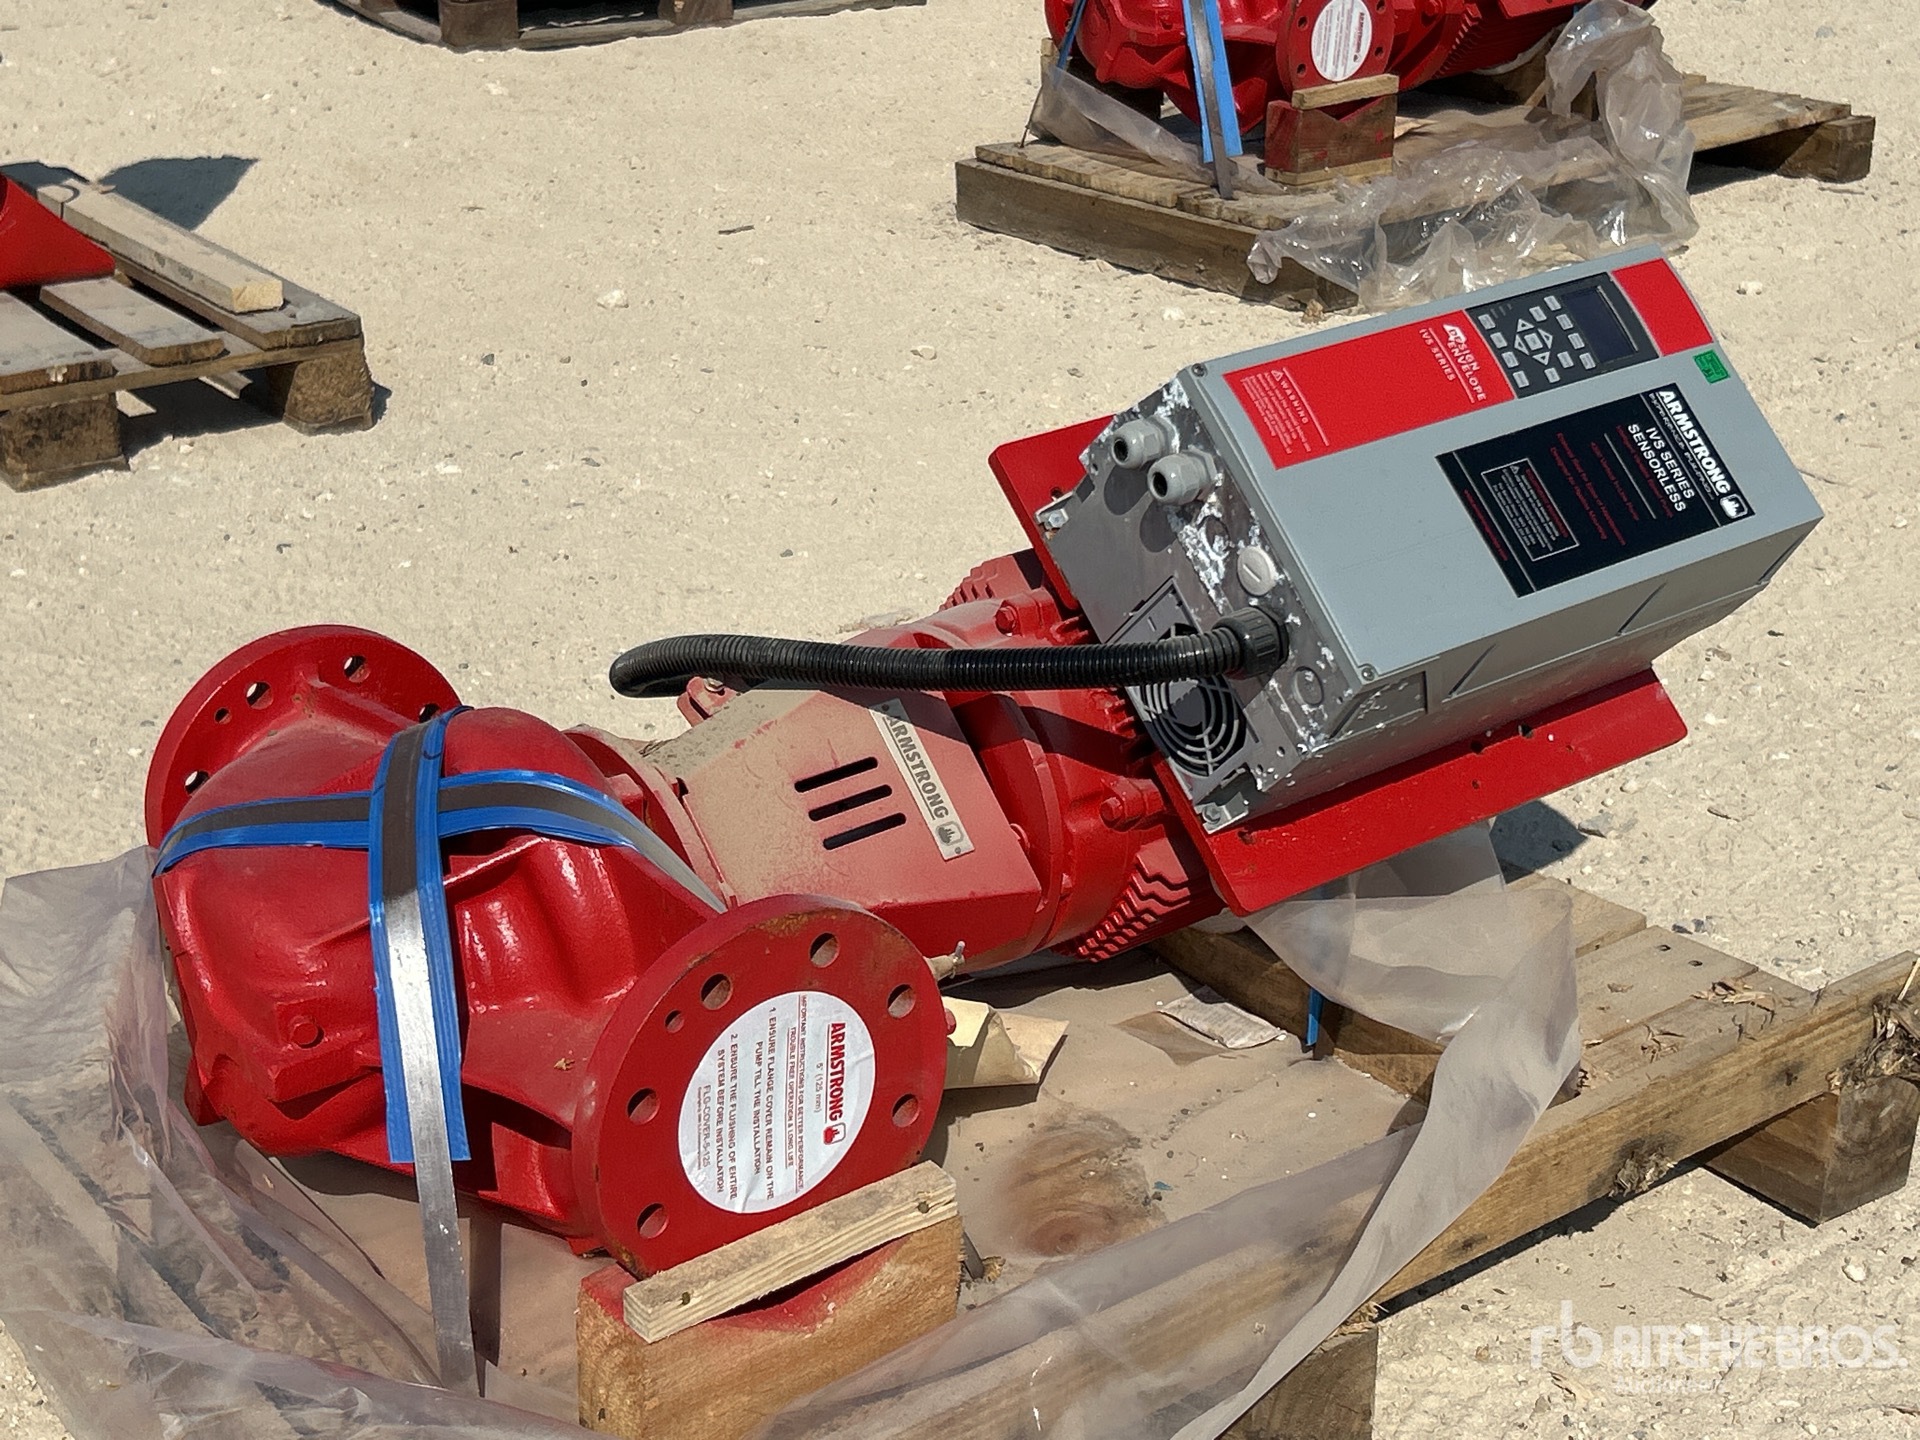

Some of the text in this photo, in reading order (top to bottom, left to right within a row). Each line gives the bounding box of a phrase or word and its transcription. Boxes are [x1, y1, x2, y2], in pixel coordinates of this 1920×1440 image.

[1417, 327, 1456, 381] IVS SERIES
[1446, 340, 1487, 401] ENVELOPE
[1279, 380, 1308, 423] WARNING
[1658, 388, 1733, 494] ARMSTRONG
[1626, 423, 1687, 511] SENSORLESS
[1644, 426, 1695, 499] IVS SERIES
[885, 714, 950, 819] ARMSTRONG
[756, 1041, 764, 1067] PUMP
[769, 1017, 777, 1054] ENSURE
[767, 1057, 775, 1092] FLANGE
[815, 1074, 823, 1092] (125
[830, 1023, 846, 1121] ARMSTRONG
[717, 1089, 725, 1126] BEFORE
[730, 1083, 738, 1102] THE
[754, 1089, 762, 1108] THE
[729, 1104, 737, 1149] FLUSHING
[729, 1151, 736, 1163] OF
[767, 1166, 773, 1179] ON
